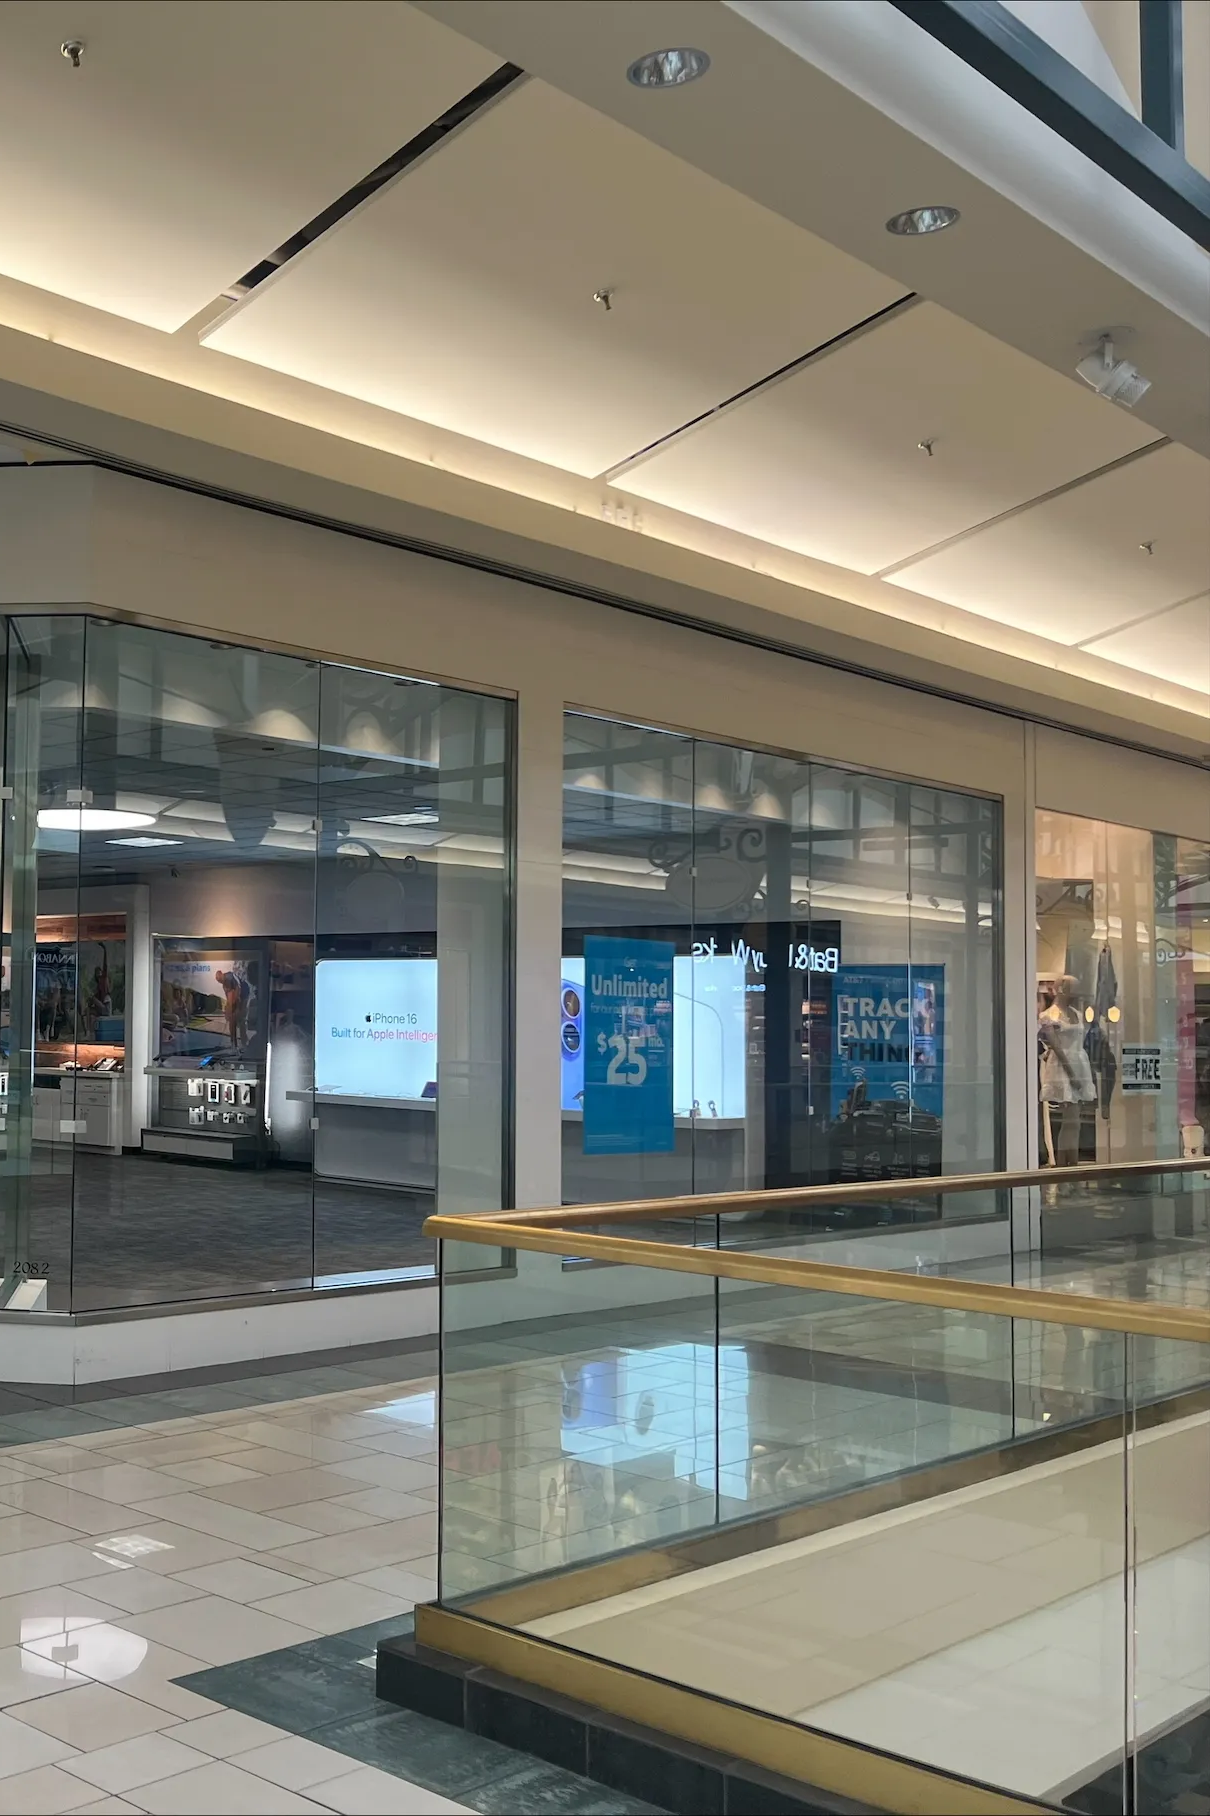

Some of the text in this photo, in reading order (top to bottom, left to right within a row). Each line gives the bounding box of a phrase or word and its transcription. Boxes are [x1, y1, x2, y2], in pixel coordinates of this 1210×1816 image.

[591, 974, 668, 999] Unlimited
[372, 1013, 418, 1025] iPhone 16
[331, 1027, 351, 1038] Built
[353, 1028, 365, 1039] for
[367, 1029, 395, 1041] Apple
[845, 1020, 896, 1040] ANY
[1135, 1058, 1161, 1080] FREE
[13, 1261, 50, 1275] 2082
